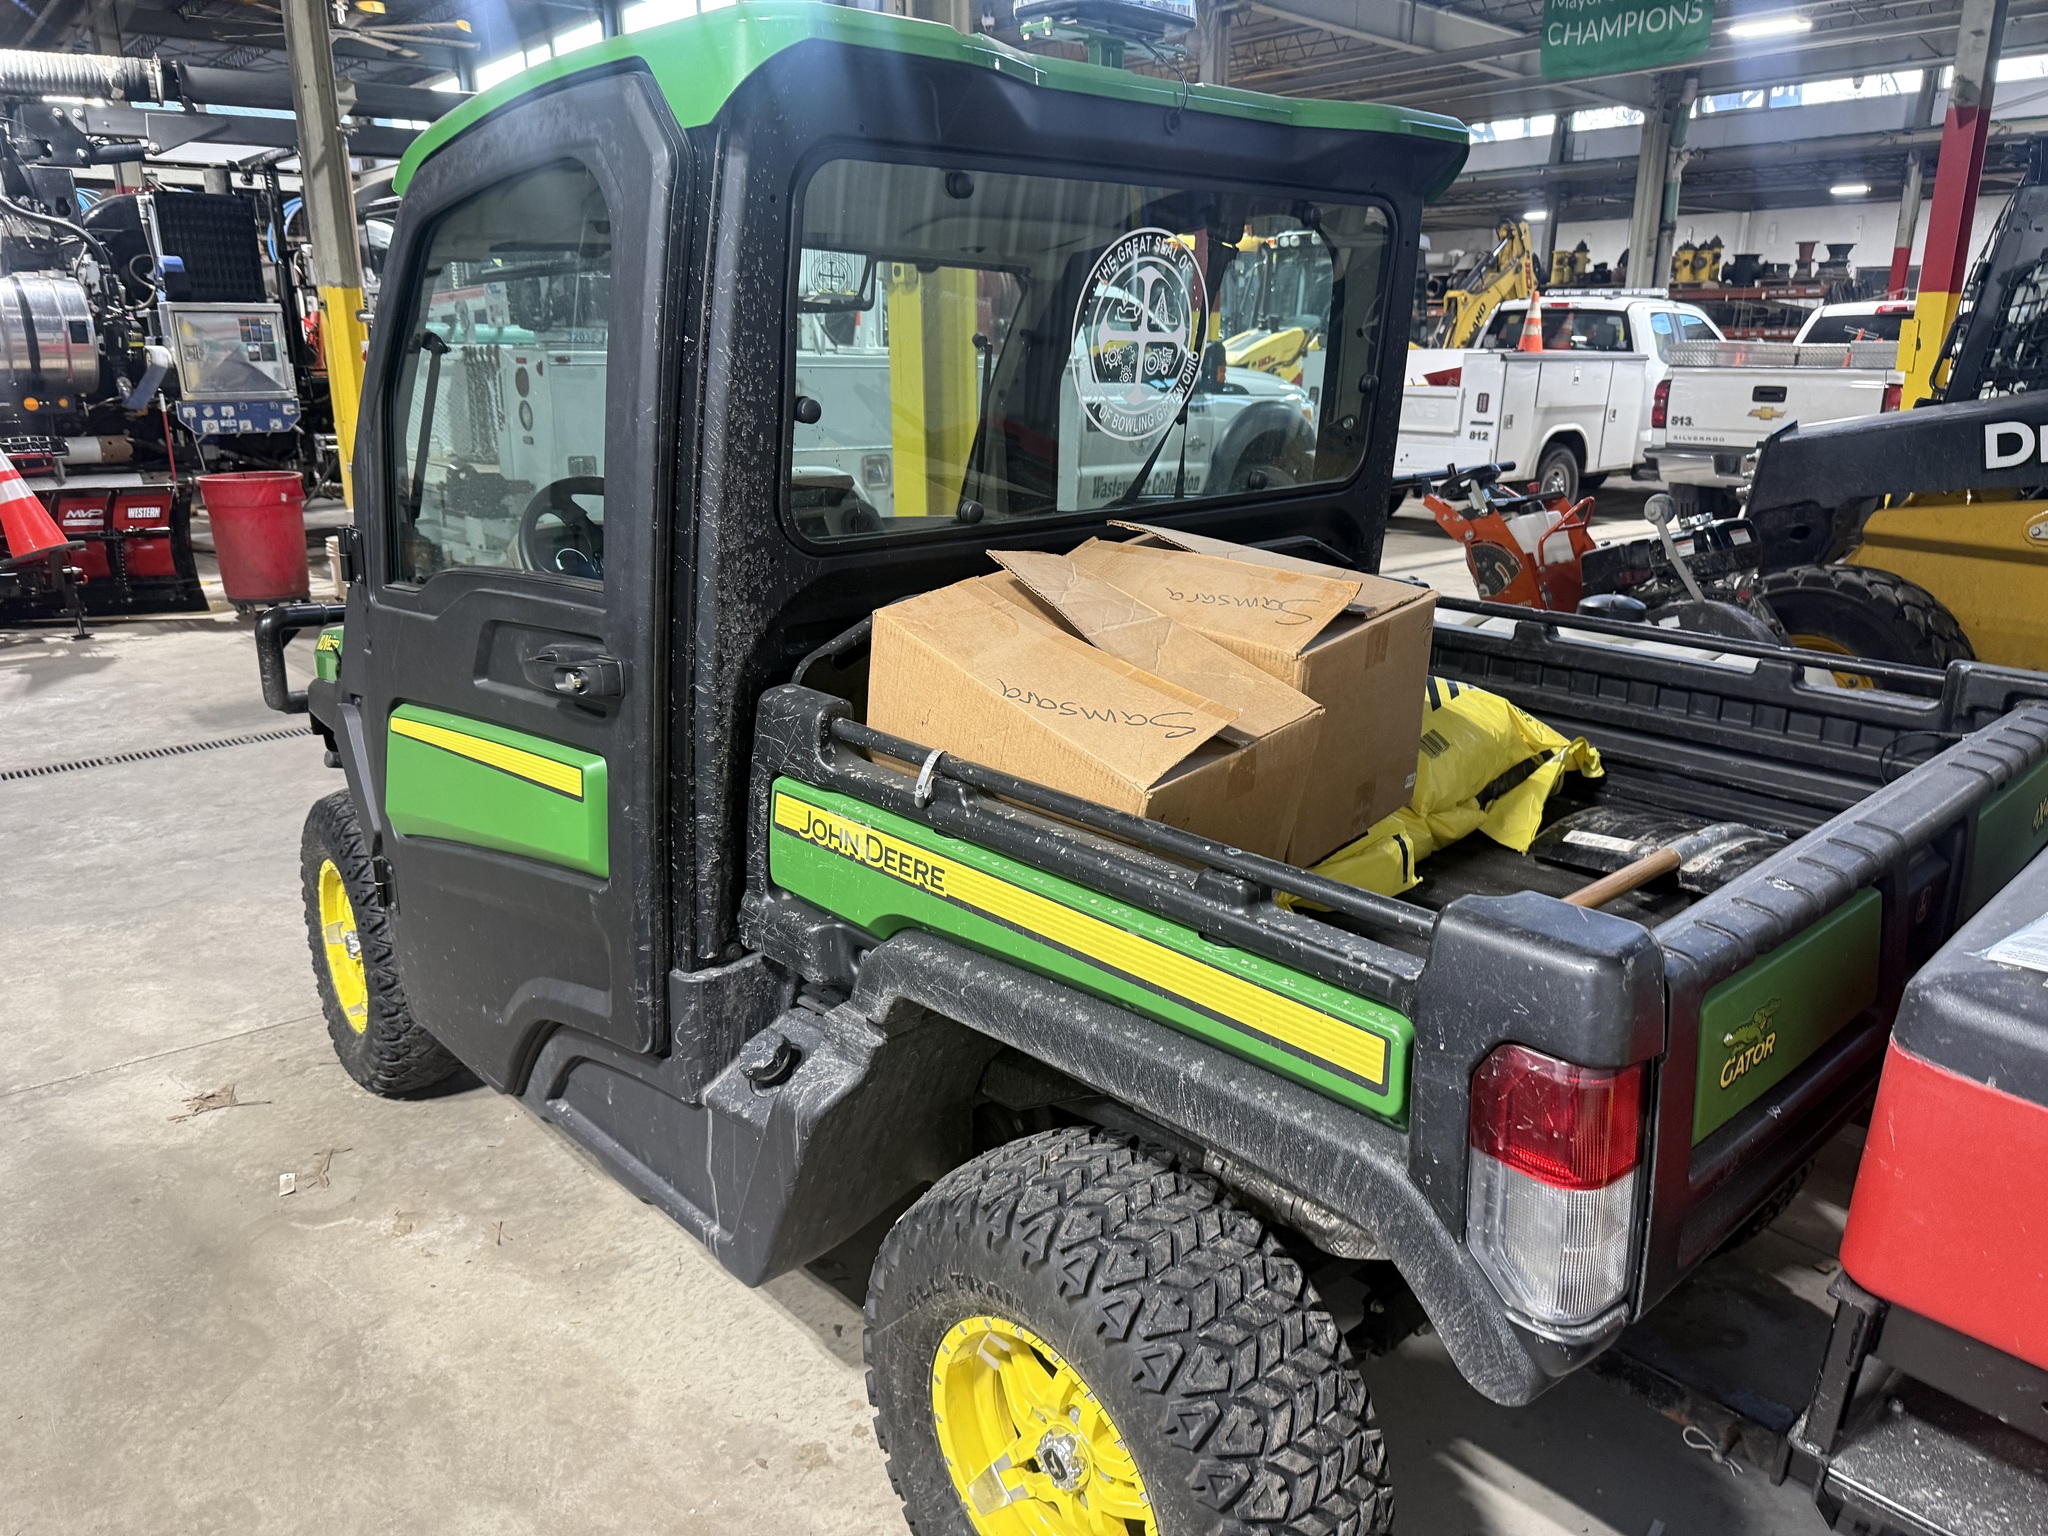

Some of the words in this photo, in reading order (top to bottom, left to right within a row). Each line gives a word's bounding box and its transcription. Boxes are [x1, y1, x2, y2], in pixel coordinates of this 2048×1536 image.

[1548, 1, 1703, 46] CHAMPIONS
[1095, 254, 1117, 284] THE
[1117, 235, 1152, 262] GREAT
[1155, 236, 1178, 262] SEAL
[1178, 254, 1193, 272] OF
[1099, 405, 1113, 422] OF
[1111, 414, 1154, 433] BOWLING
[1182, 351, 1199, 384] OHIO
[1469, 431, 1488, 440] 812
[65, 509, 104, 518] MVP
[127, 507, 161, 519] WESTERN
[1165, 588, 1320, 626] Samsara
[998, 678, 1197, 739] Samsara
[800, 810, 860, 856] JOHN
[866, 833, 946, 892] DEERE
[1720, 1032, 1776, 1089] GATOR
